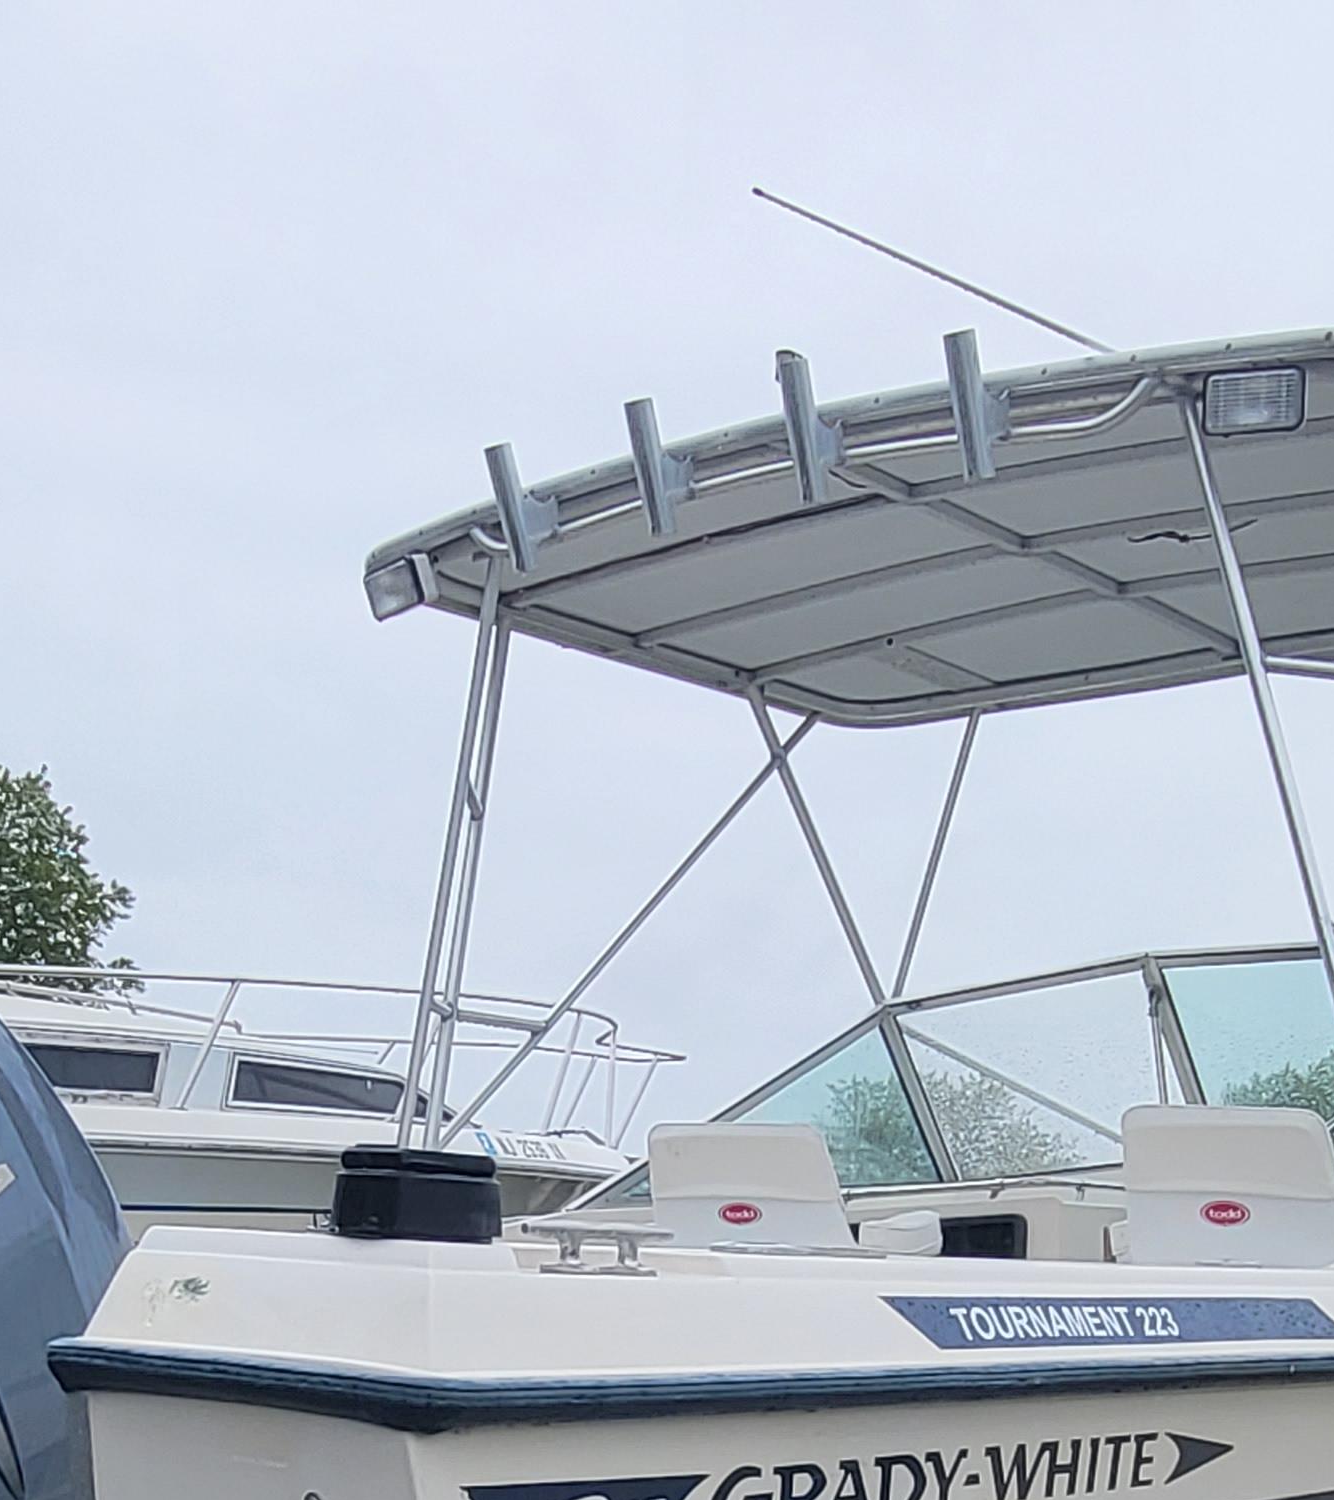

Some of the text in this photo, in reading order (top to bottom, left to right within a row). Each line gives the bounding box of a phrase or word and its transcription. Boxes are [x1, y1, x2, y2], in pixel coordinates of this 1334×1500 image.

[725, 1208, 755, 1219] todd
[1208, 1208, 1242, 1219] todd
[949, 1305, 1180, 1341] TOURNAMENT 223
